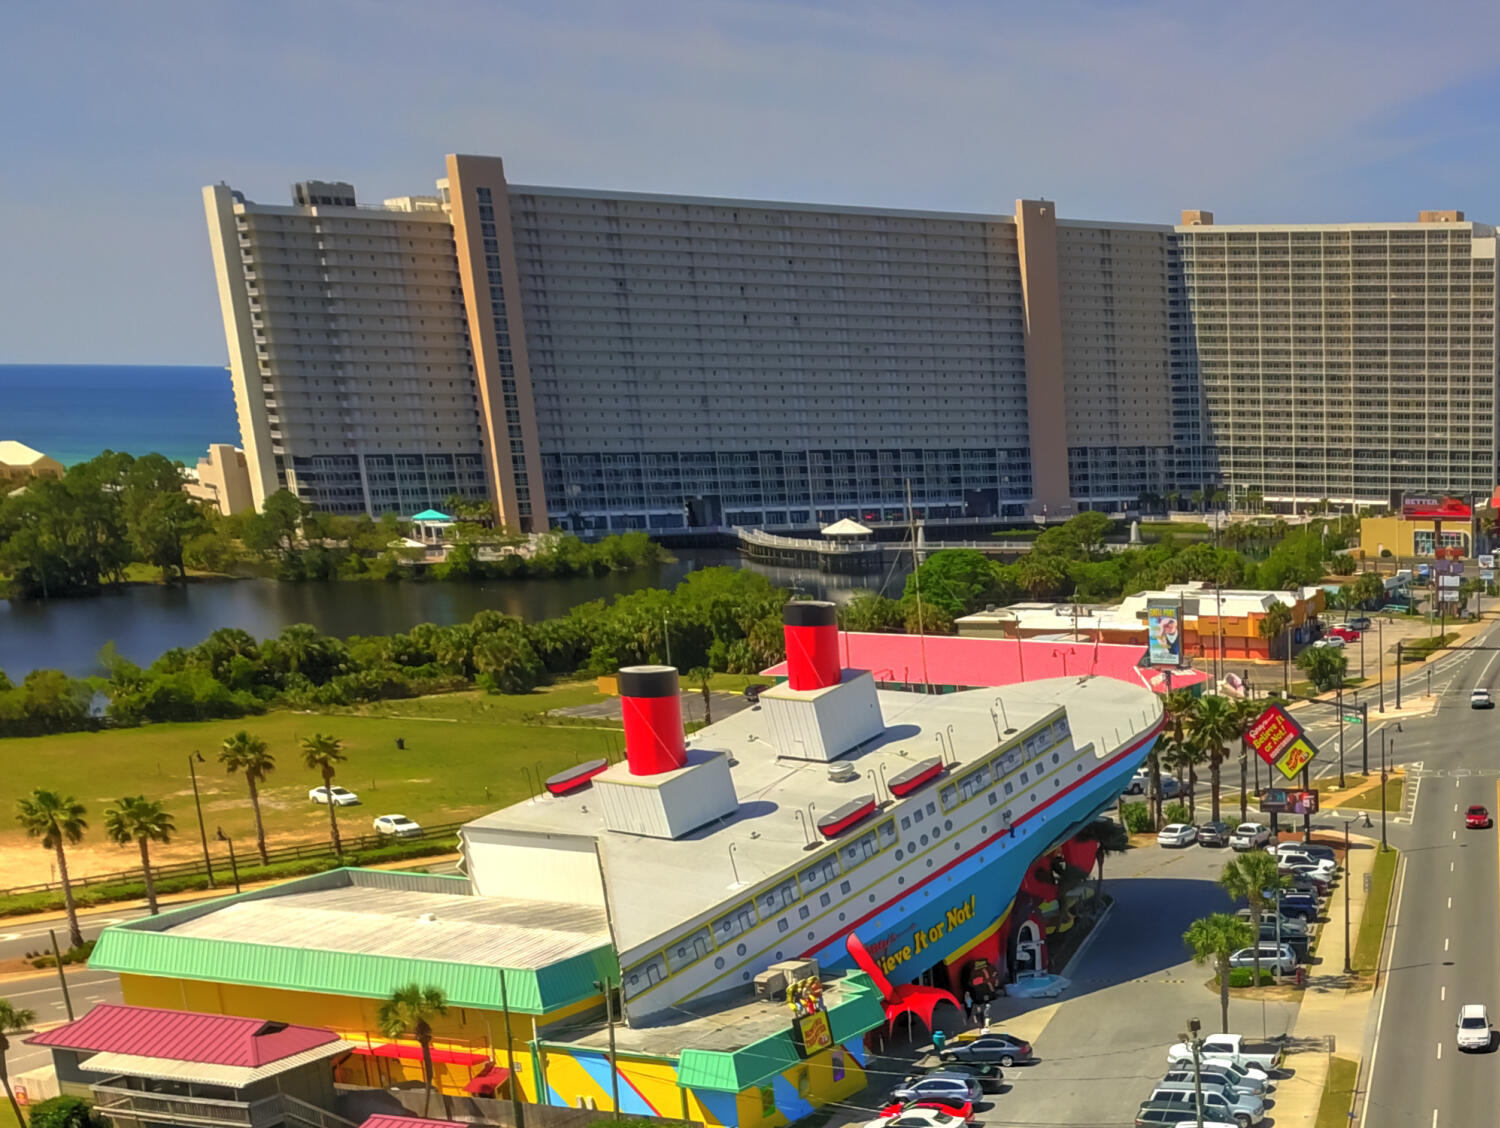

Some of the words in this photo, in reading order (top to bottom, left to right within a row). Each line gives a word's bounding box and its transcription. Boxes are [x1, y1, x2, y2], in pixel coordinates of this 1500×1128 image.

[1253, 724, 1277, 749] Believe
[1264, 742, 1273, 752] or
[877, 946, 912, 975] lieve
[914, 930, 928, 954] It
[928, 922, 944, 942] or
[946, 894, 976, 932] Not!
